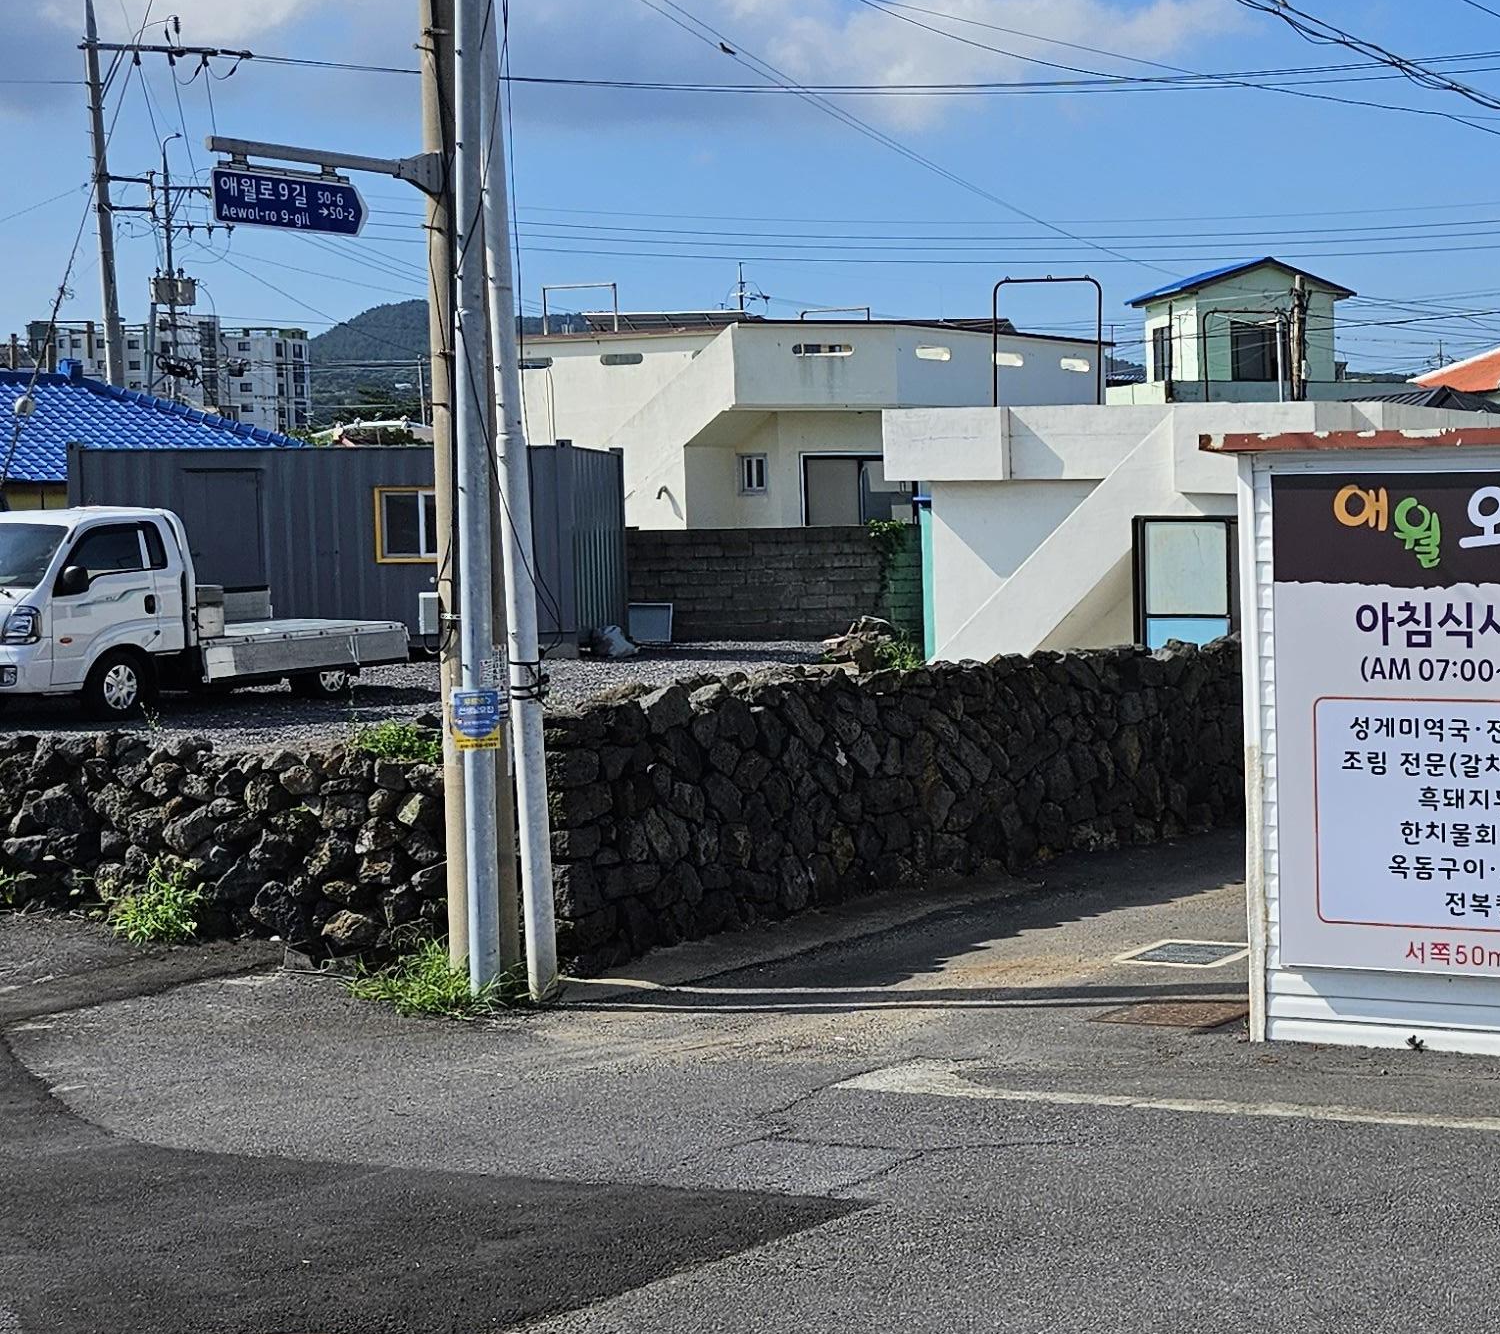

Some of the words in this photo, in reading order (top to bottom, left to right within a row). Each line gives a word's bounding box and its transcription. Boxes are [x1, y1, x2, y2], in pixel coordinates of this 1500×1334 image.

[317, 190, 344, 206] 50-6
[222, 203, 277, 222] Aewol-ro
[281, 210, 311, 227] 9-gil
[329, 207, 356, 221] 50-2
[1333, 484, 1441, 568] 애월
[1360, 656, 1412, 683] (AM
[1341, 750, 1388, 776] 조림
